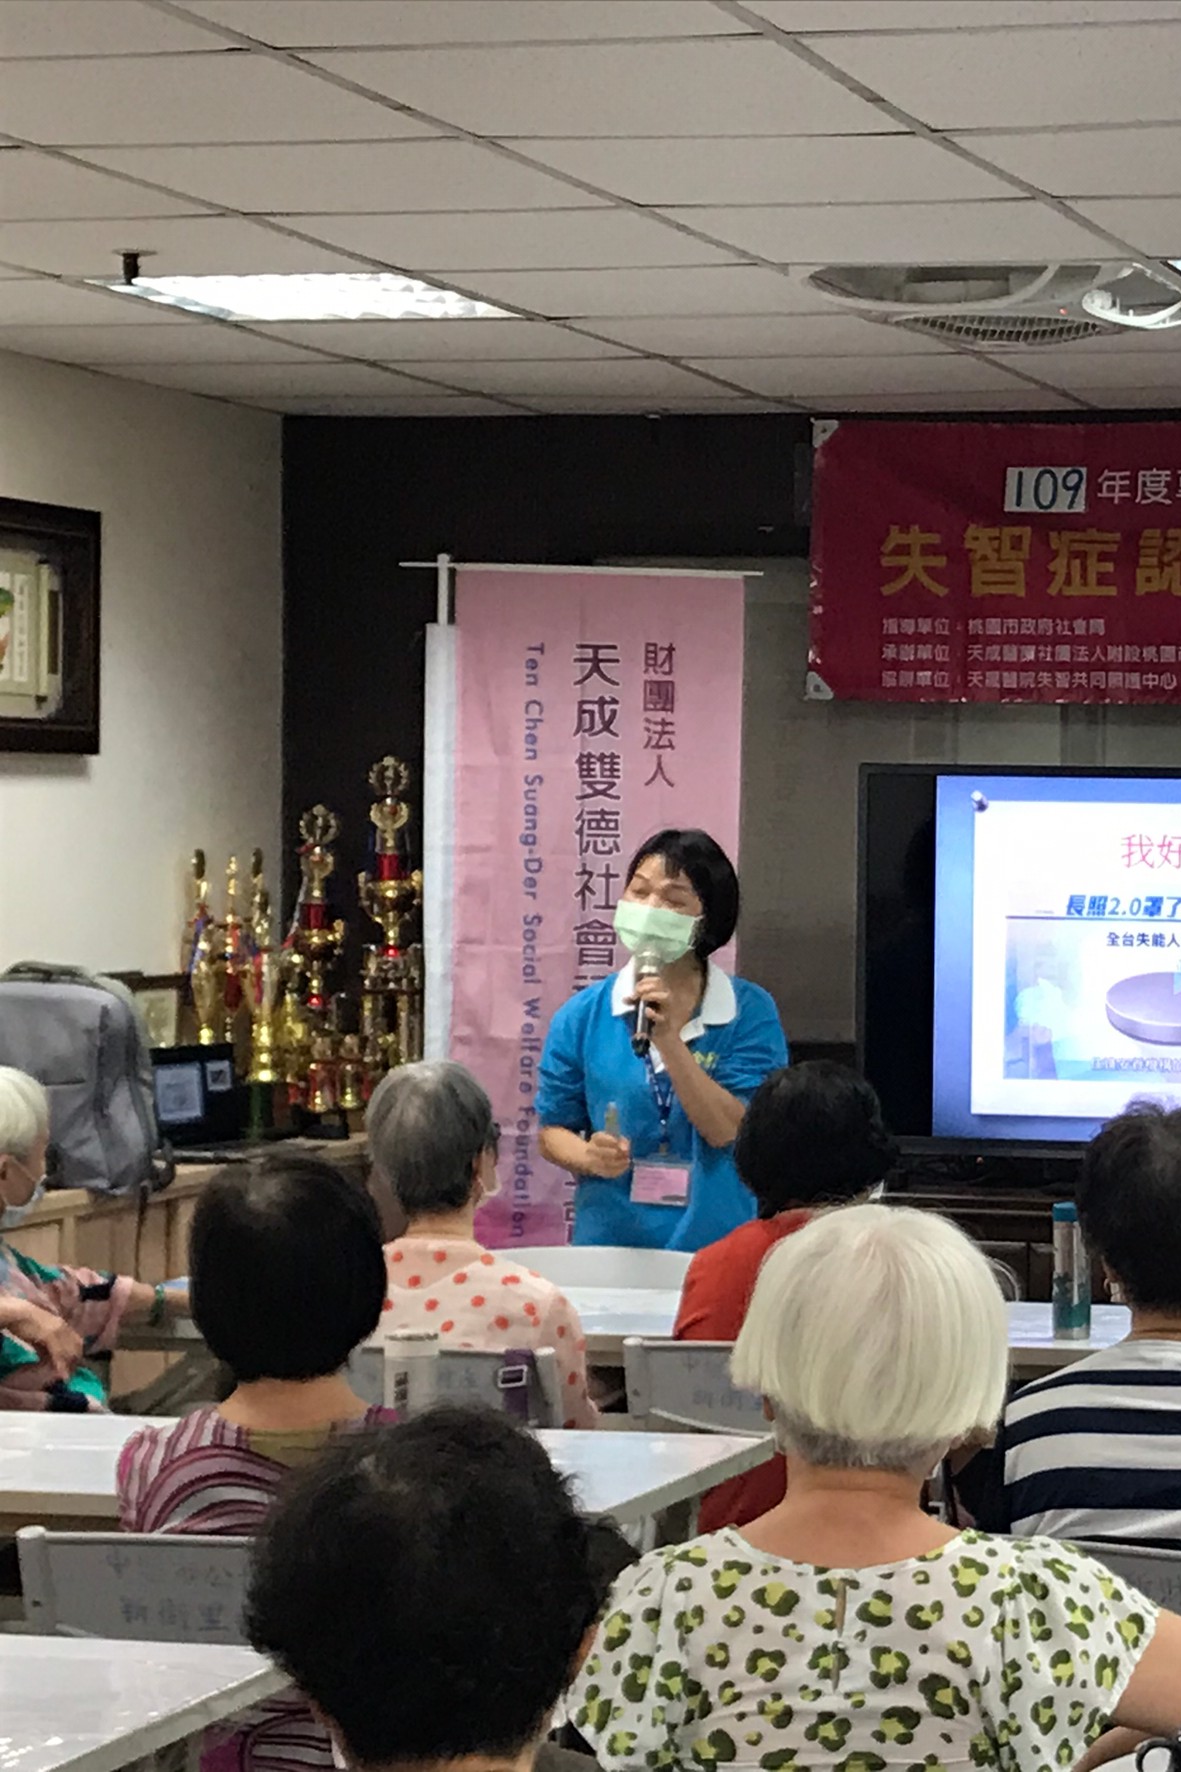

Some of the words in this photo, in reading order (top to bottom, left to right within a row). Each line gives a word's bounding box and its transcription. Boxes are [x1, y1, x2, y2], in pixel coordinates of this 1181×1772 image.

[525, 642, 546, 687] Ten
[642, 641, 677, 789] 財團法人
[524, 700, 545, 761] Chen
[519, 774, 545, 900] Suang-Der
[572, 643, 622, 989] 天成雙德社會
[522, 913, 544, 985] Social
[518, 996, 542, 1094] Welfare
[510, 1106, 537, 1238] Foundation
